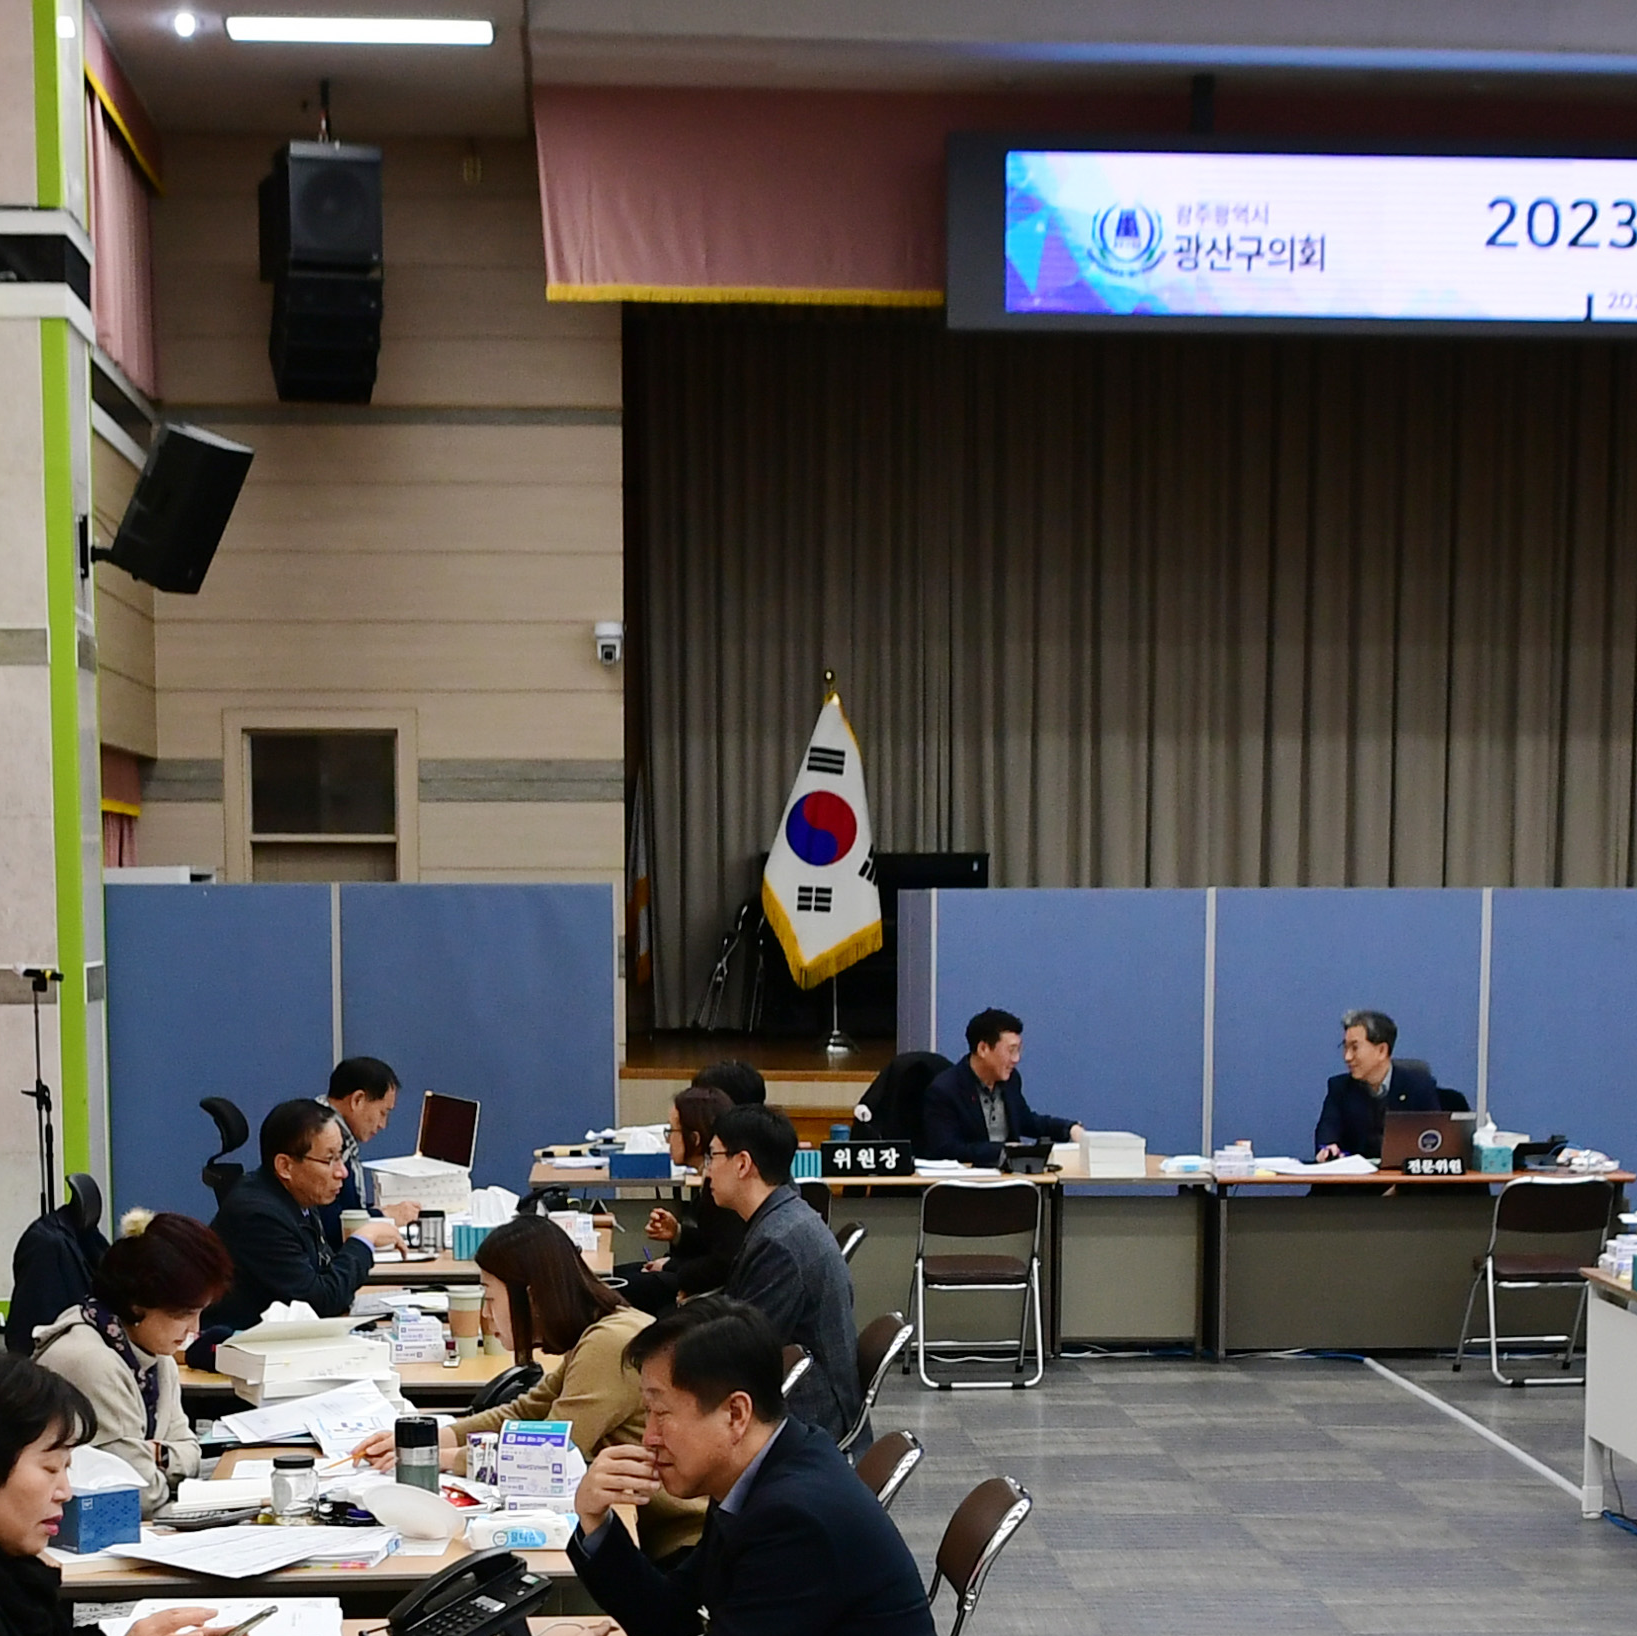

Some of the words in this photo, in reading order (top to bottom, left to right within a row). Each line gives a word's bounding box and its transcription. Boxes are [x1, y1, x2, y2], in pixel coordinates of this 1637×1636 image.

[1173, 232, 1326, 273] 광산구의회
[832, 1147, 901, 1170] 위원장
[1407, 1158, 1463, 1175] 전문위원
